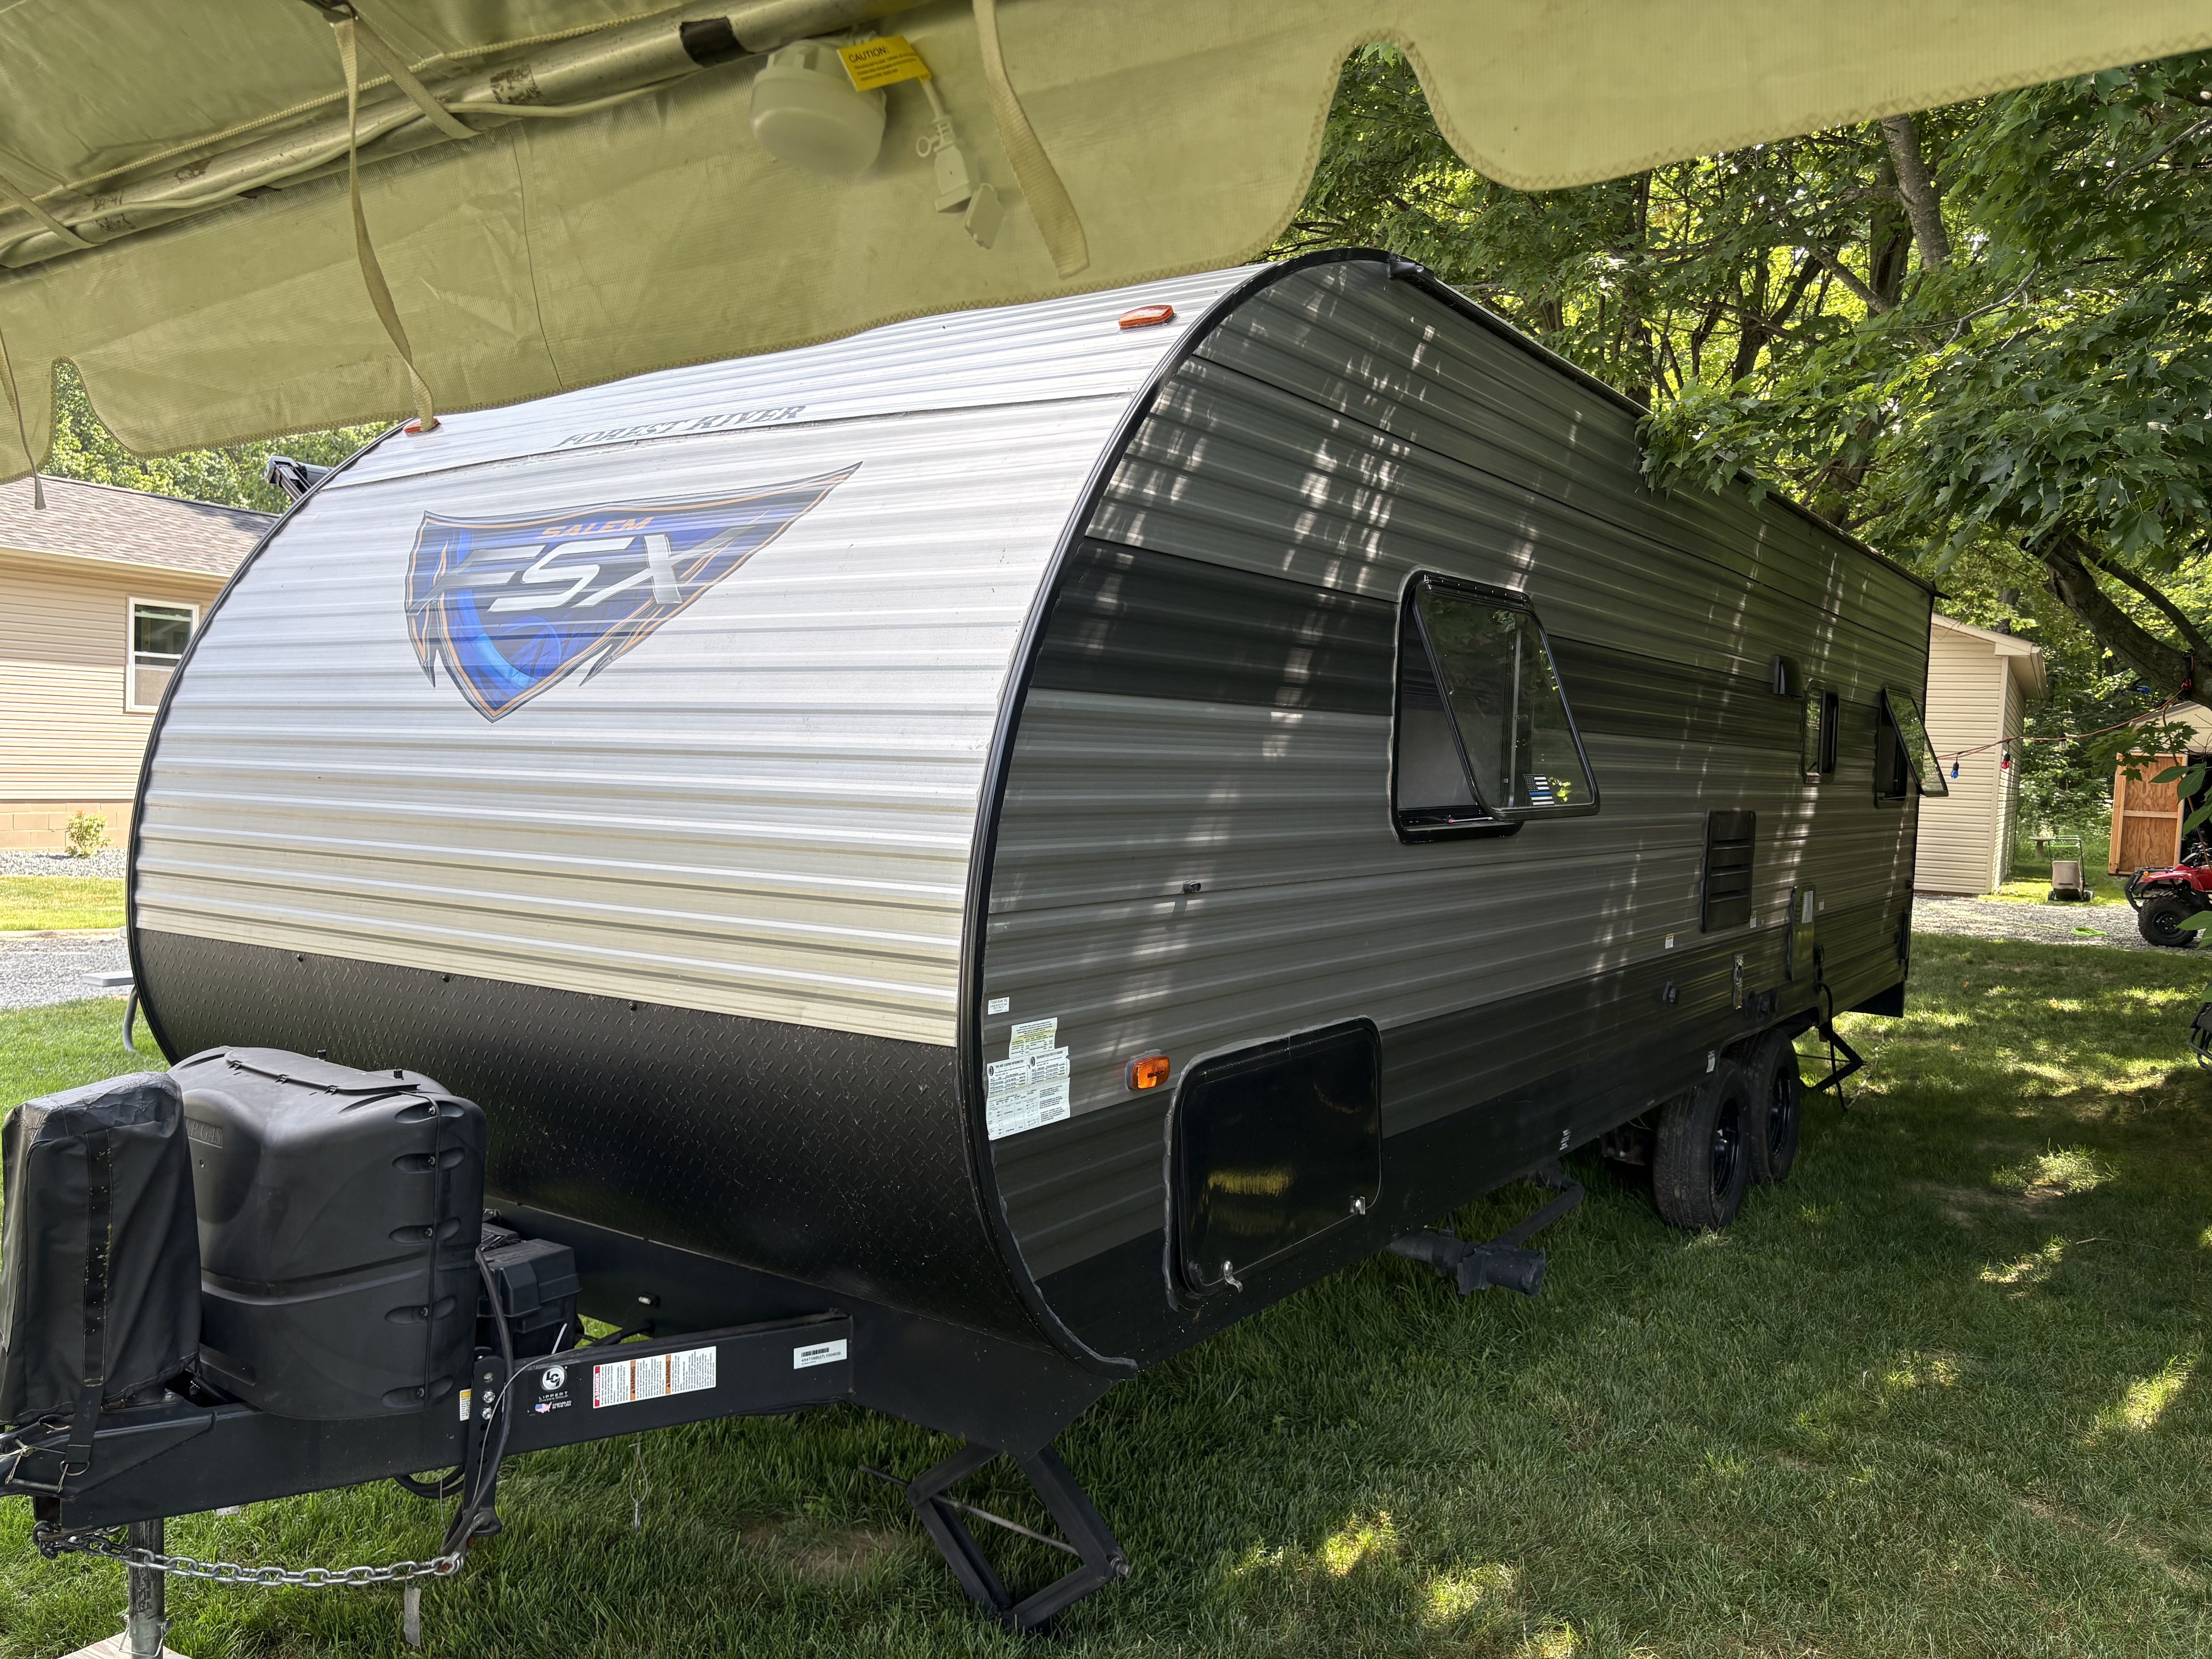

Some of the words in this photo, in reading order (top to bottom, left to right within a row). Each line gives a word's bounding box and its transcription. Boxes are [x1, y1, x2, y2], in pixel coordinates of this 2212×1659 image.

[553, 421, 689, 447] FOREST
[682, 405, 806, 430] RIVER
[536, 517, 654, 539] SALEM
[201, 1124, 223, 1145] GAS
[539, 1391, 568, 1400] LIPPERT
